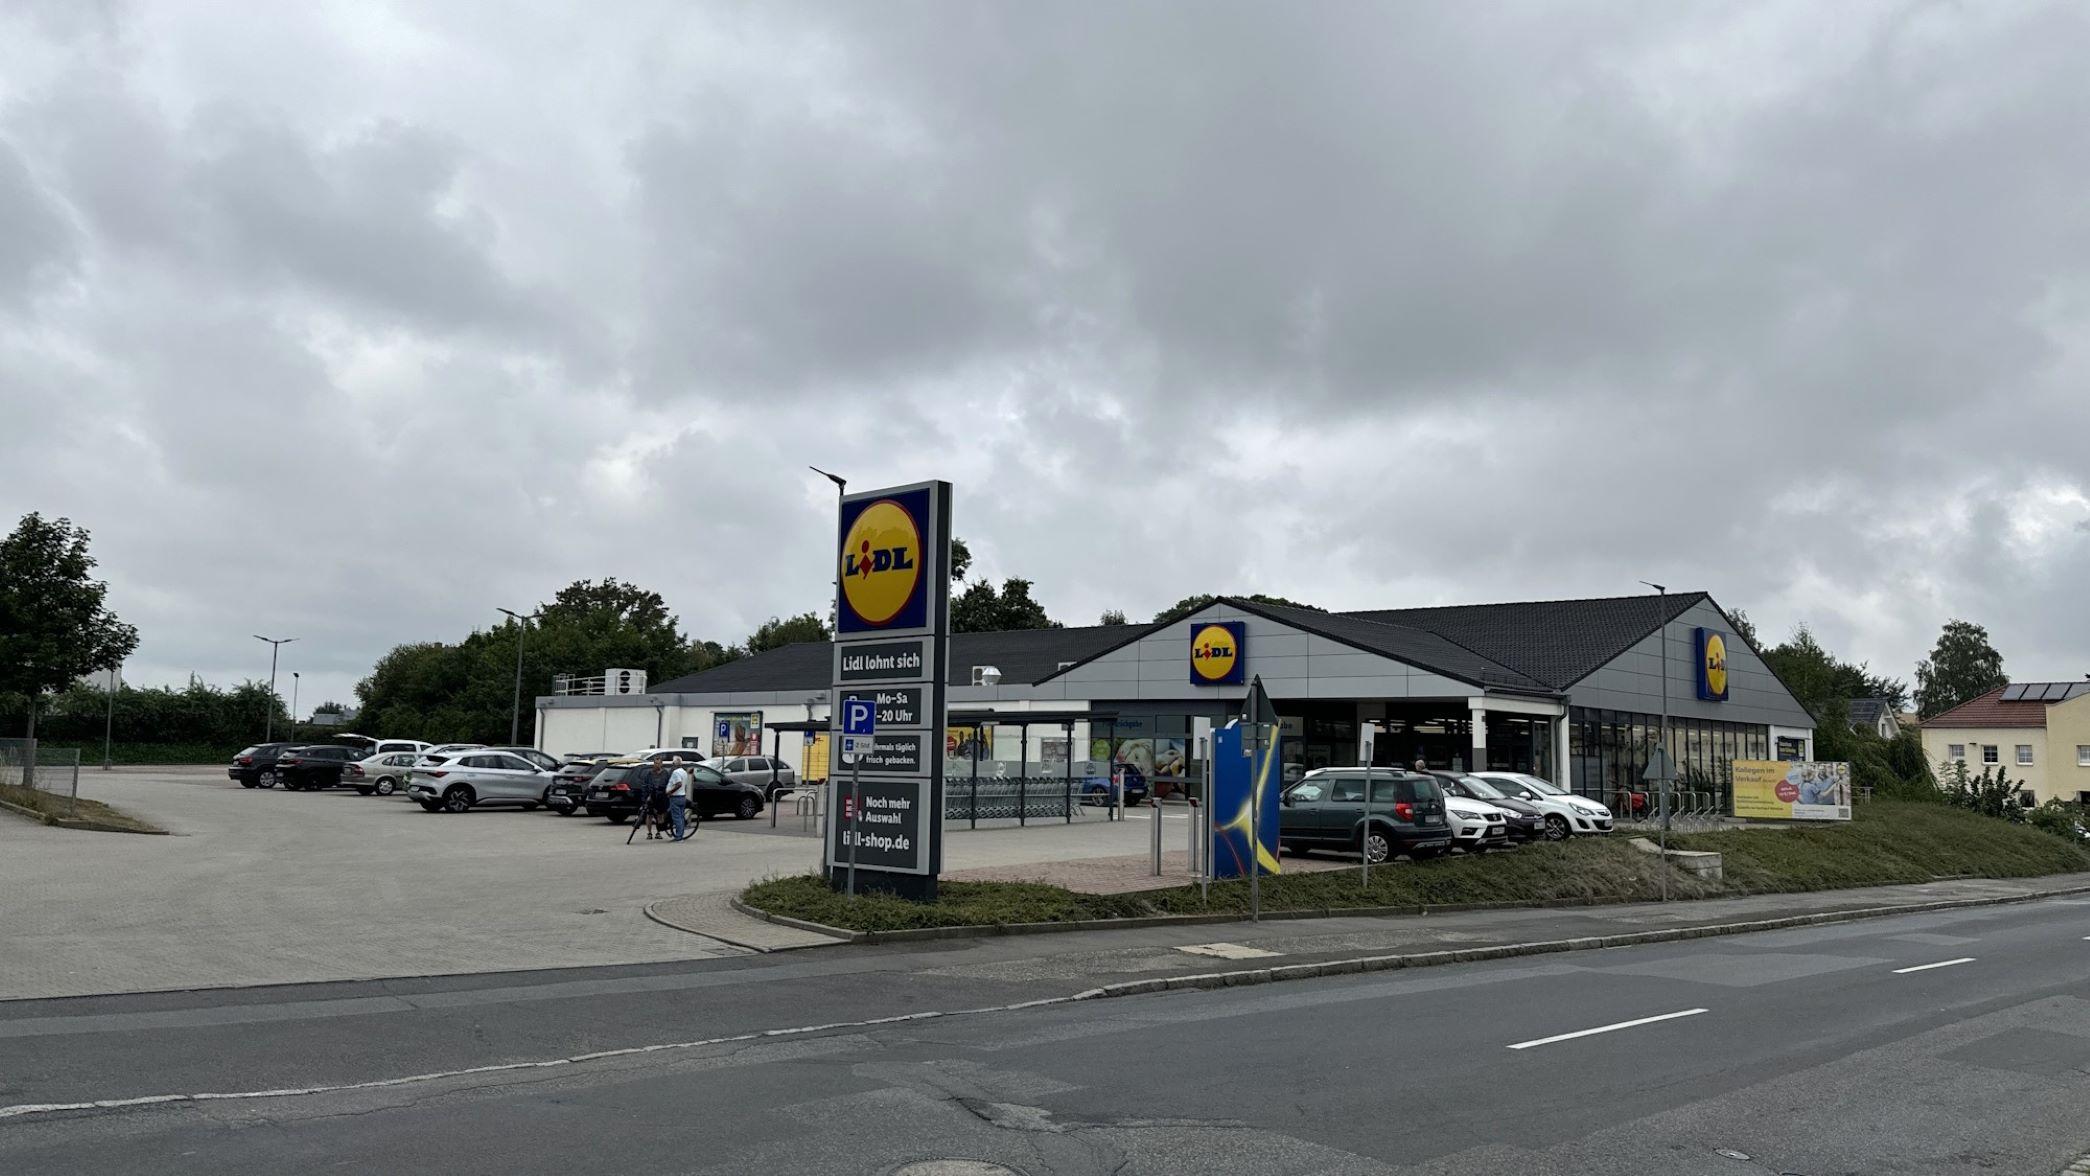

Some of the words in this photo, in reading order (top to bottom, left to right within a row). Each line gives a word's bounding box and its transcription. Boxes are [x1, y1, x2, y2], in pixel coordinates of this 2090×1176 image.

[843, 655, 864, 671] Lidl
[865, 654, 895, 670] lohnt
[897, 652, 920, 668] sich
[850, 704, 868, 731] P
[895, 709, 913, 722] Uhr
[895, 743, 916, 753] täglich
[866, 754, 883, 764] frisch
[885, 755, 916, 766] gebacken.
[866, 796, 887, 809] Noch
[888, 797, 911, 810] mehr
[865, 811, 902, 824] Auswahl
